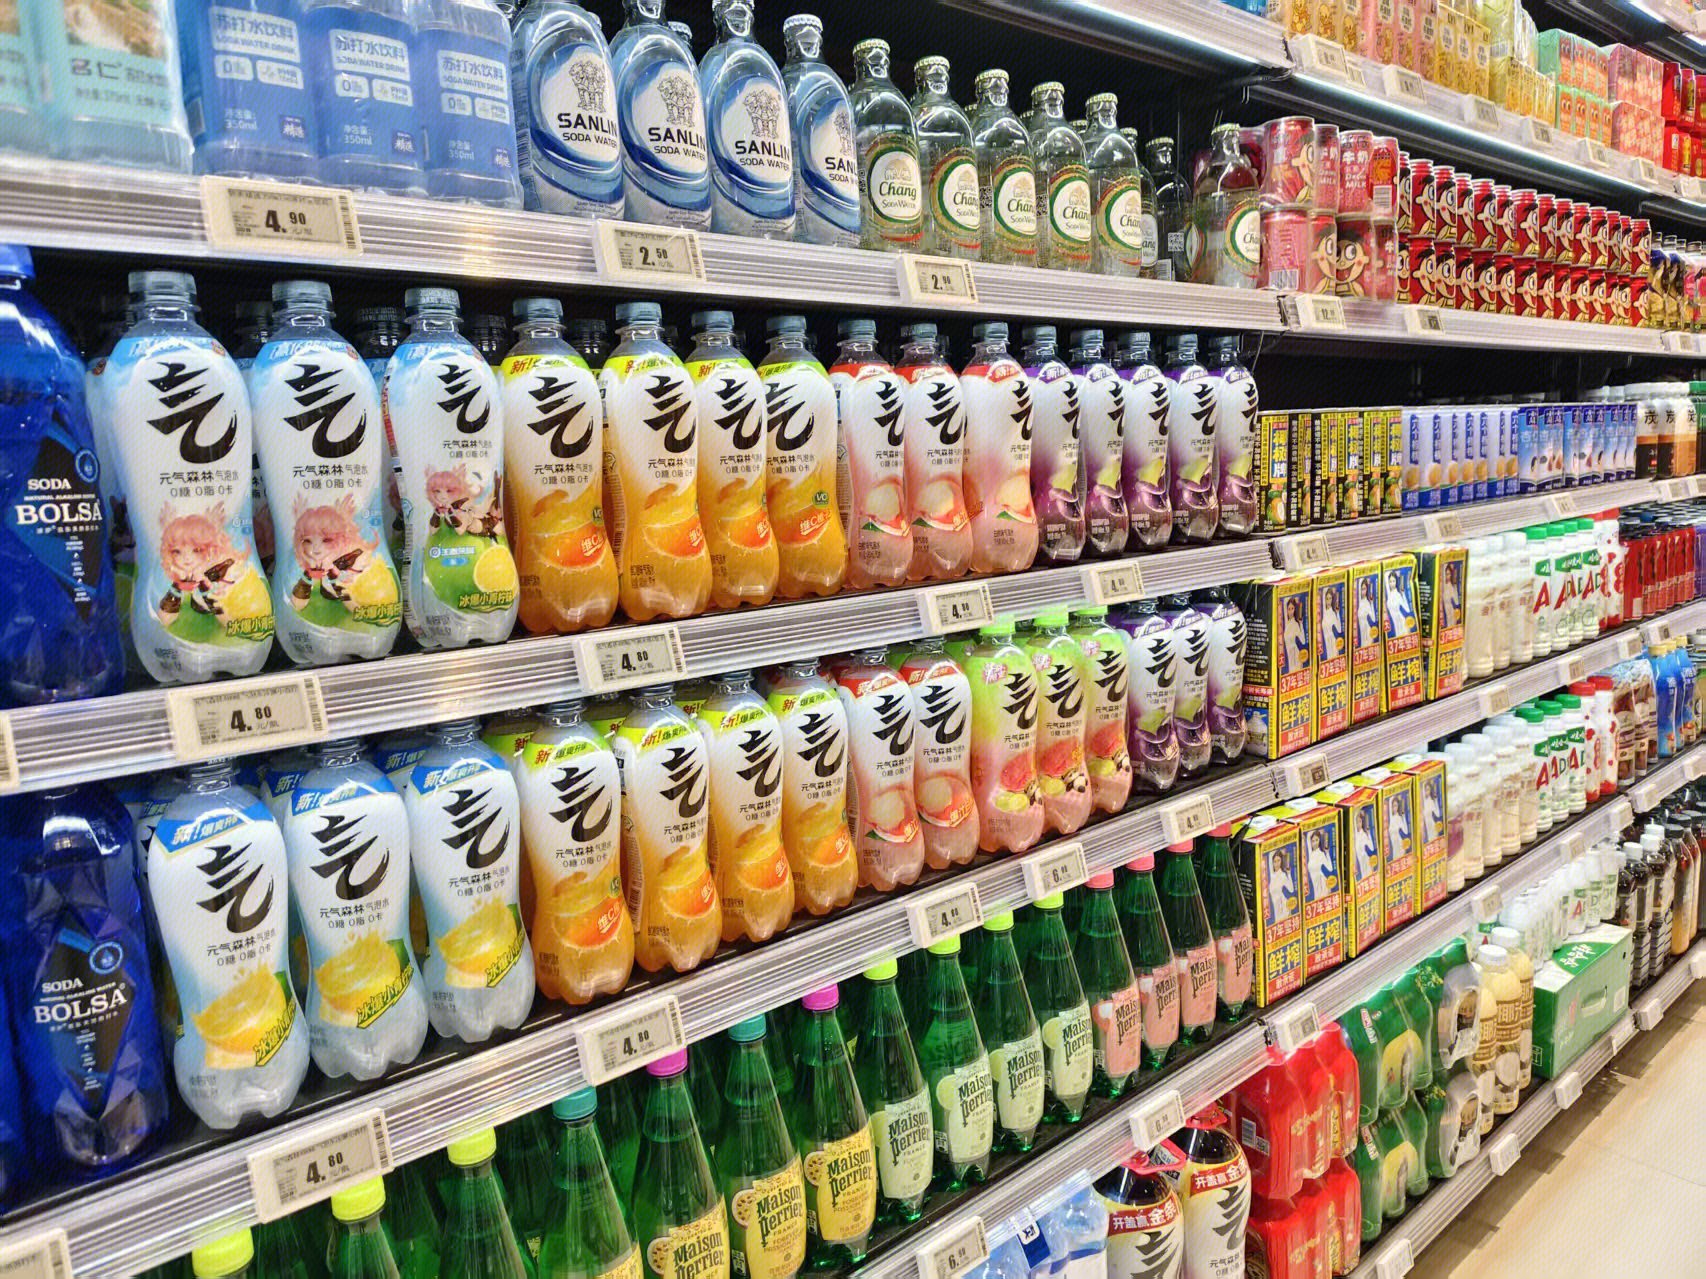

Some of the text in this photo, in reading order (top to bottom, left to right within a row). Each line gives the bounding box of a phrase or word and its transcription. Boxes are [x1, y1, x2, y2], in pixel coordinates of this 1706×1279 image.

[335, 36, 406, 61] 苏打水饮料
[442, 56, 503, 81] 苏打水饮料
[557, 112, 618, 138] SANLIN
[648, 127, 706, 151] SANLIN
[562, 132, 618, 149] SODA WATER
[654, 145, 706, 161] SODA WATER
[735, 140, 790, 161] SANLIN
[739, 157, 790, 172] SODA WATER
[829, 173, 849, 183] SODA
[879, 181, 917, 202] Chang
[265, 209, 307, 233] 4.90
[639, 246, 668, 267] 2.50
[147, 362, 237, 463] 气
[284, 364, 366, 458] 气
[437, 364, 490, 434] 气
[528, 376, 593, 458] 气
[27, 478, 72, 491] SODA
[14, 502, 102, 526] BOLSA
[620, 649, 649, 673] 4.80
[230, 705, 272, 733] 4.80
[920, 685, 968, 744] 气
[549, 765, 613, 842] 气
[441, 787, 511, 869] 气
[310, 814, 389, 900] 气
[196, 842, 274, 934] 气
[1305, 895, 1340, 920] 37年坚持
[1306, 921, 1340, 954] 鲜榨
[41, 977, 83, 994] SODA
[33, 987, 128, 1024] BOLSA
[622, 1029, 650, 1057] 4.80
[889, 1111, 928, 1140] Maison
[305, 1151, 344, 1186] 4.80
[827, 1149, 872, 1179] Maison
[757, 1183, 802, 1218] Maison
[673, 1231, 723, 1268] Maison
